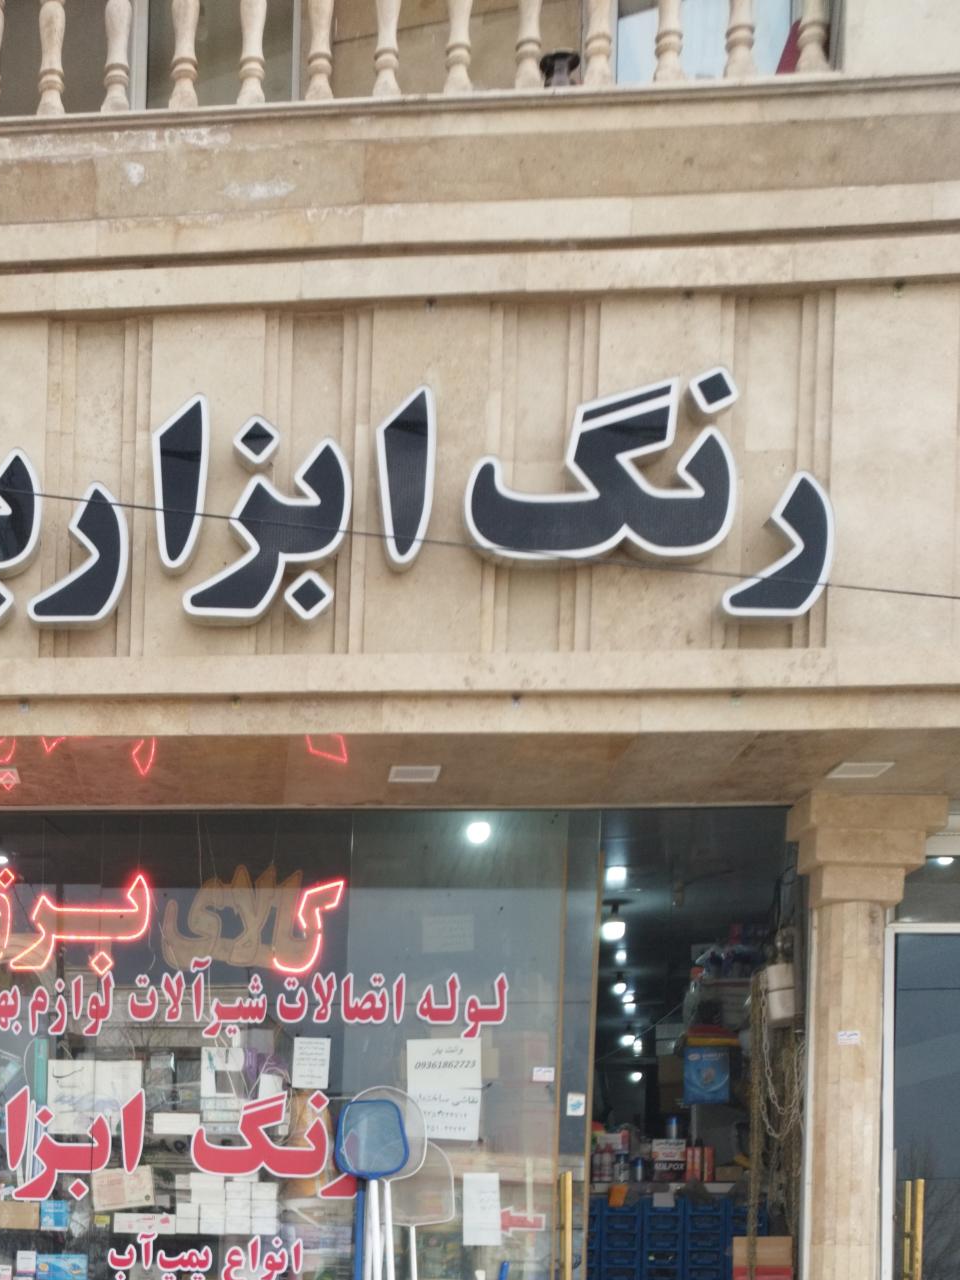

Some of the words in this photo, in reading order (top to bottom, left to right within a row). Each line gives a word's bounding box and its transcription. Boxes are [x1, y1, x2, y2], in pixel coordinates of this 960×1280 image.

[27, 382, 435, 627] ابزار
[463, 365, 835, 618] رنگ
[28, 971, 117, 1036] لوازم
[276, 972, 406, 1024] اتصالات
[417, 971, 509, 1039] لوله
[190, 1089, 362, 1199] رنگ
